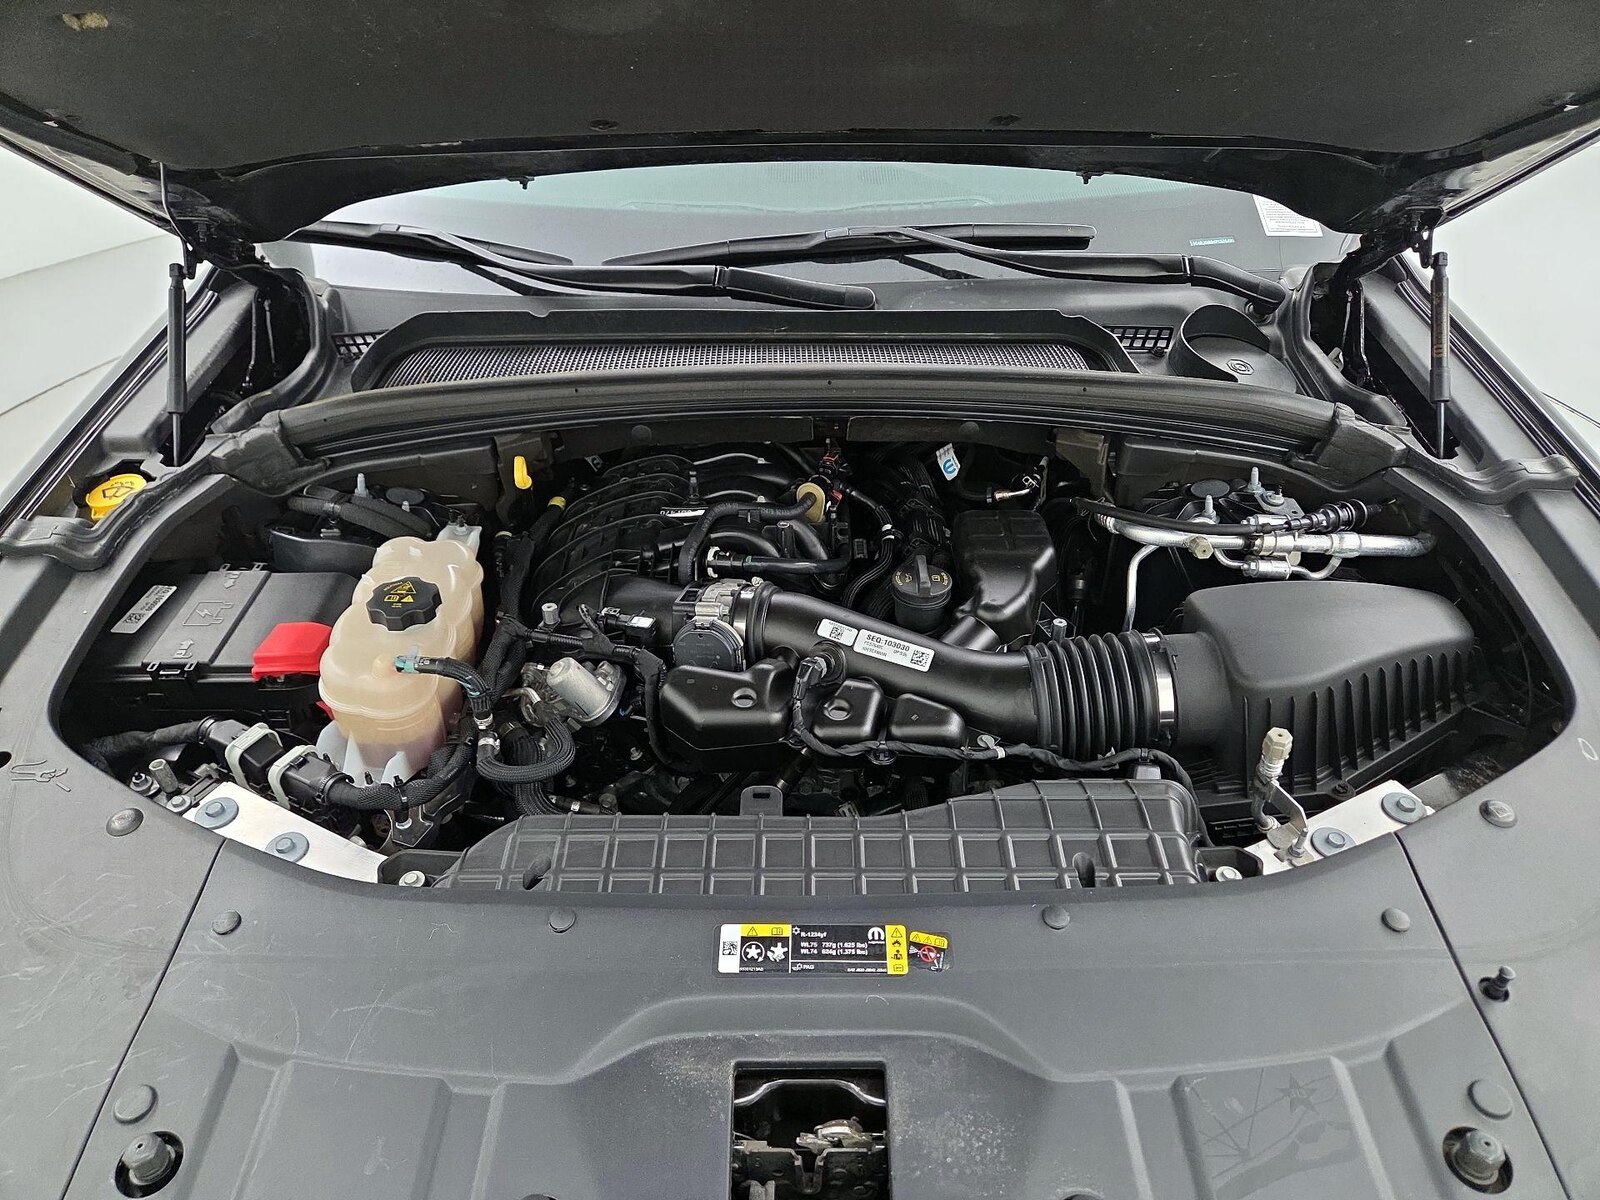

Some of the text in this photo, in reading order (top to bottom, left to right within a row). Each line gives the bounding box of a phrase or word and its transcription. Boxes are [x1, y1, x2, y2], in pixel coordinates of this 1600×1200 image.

[866, 633, 910, 652] SEQ:103030
[800, 931, 827, 939] R-1234yf
[821, 941, 837, 949] 737g
